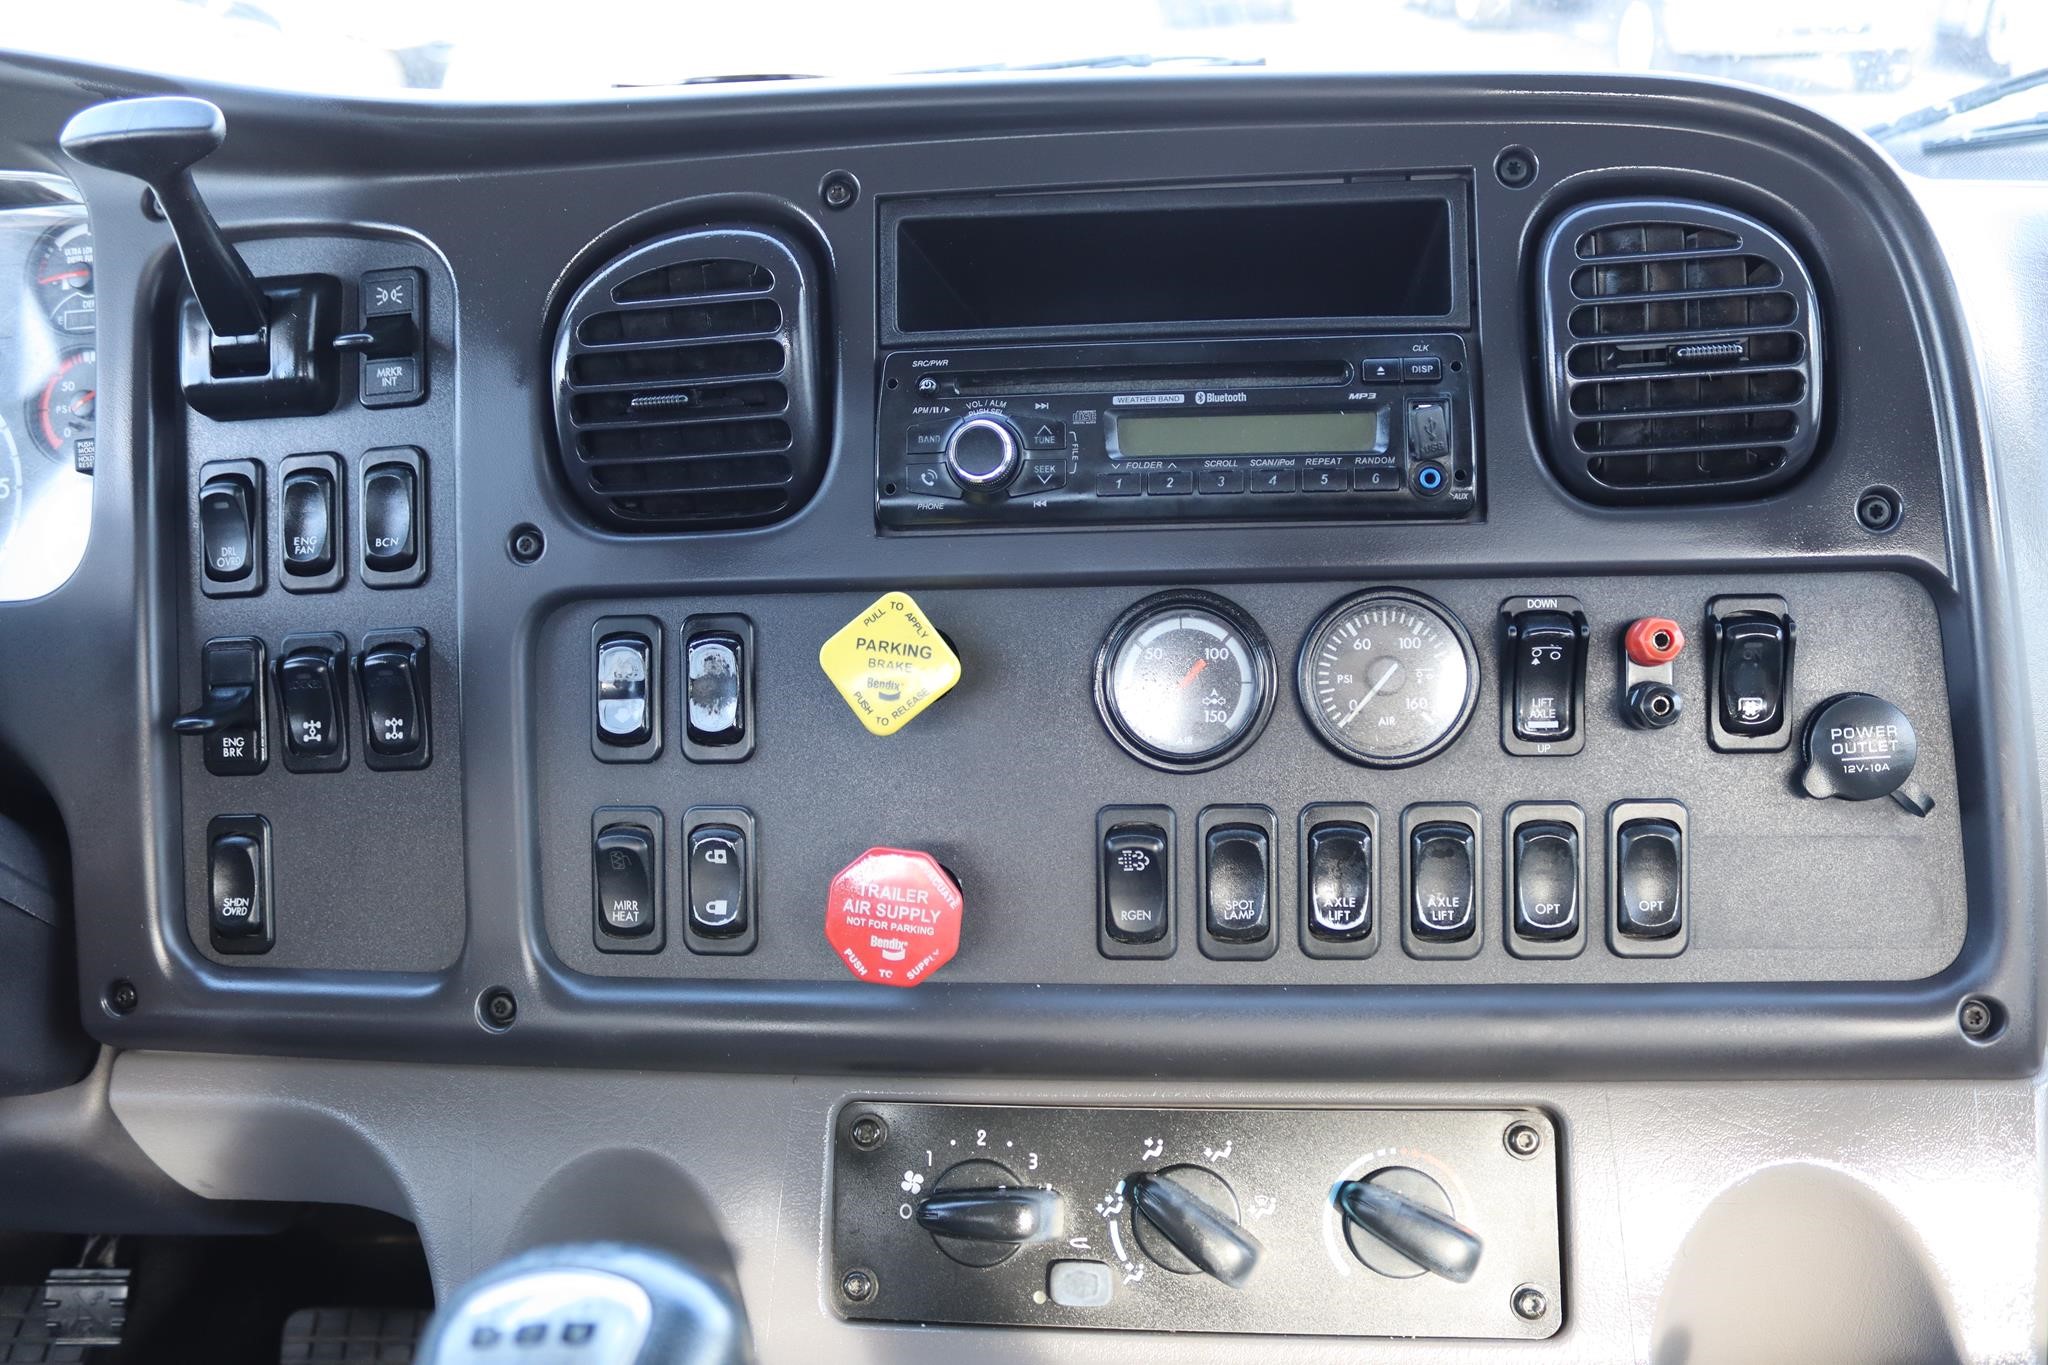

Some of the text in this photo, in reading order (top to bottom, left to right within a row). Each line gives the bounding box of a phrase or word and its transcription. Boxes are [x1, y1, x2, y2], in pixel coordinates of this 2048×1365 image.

[1412, 344, 1429, 352] CLK
[912, 359, 949, 368] SRC/PWR
[1411, 365, 1434, 373] DISP
[376, 366, 403, 378] MRKR
[61, 381, 75, 392] 50
[381, 376, 398, 387] INT
[1118, 395, 1180, 404] WEATHER BAND
[1206, 392, 1247, 402] Bluetooth
[1348, 392, 1377, 400] MP3
[966, 400, 983, 409] VOL
[989, 400, 1007, 409] ALM
[64, 428, 72, 438] 0
[918, 435, 941, 443] BAND
[1034, 436, 1056, 444] TUNE
[1126, 461, 1163, 469] FOLDER
[1204, 460, 1238, 468] SCROLL
[1250, 458, 1295, 467] SCAN/iPod
[1305, 457, 1343, 466] REPEAT
[1354, 457, 1396, 465] RANDOM
[1034, 465, 1056, 473] SEEK
[1115, 478, 1122, 489] 1
[1166, 477, 1174, 488] 2
[1218, 476, 1225, 487] 3
[1268, 475, 1277, 486] 4
[1320, 473, 1329, 485] 5
[1371, 473, 1380, 484] 6
[917, 502, 944, 511] PHONE
[293, 536, 318, 546] ENG
[375, 537, 399, 547] BCN
[221, 547, 237, 557] DRL
[294, 545, 315, 555] FAN
[217, 557, 241, 568] OVRD
[1527, 599, 1558, 609] DOWN
[863, 601, 929, 639] PULL TO APPLY
[856, 637, 932, 660] PARKING
[1353, 638, 1371, 650] 60
[1399, 637, 1421, 649] 100
[1204, 647, 1229, 660] 100
[868, 657, 913, 673] BRAKE
[867, 677, 900, 691] Bendix
[1337, 674, 1353, 684] PSI
[854, 687, 930, 726] PUSH TO RELEASE
[1406, 698, 1428, 710] 160
[1532, 697, 1554, 707] LIFT
[1204, 710, 1227, 723] 150
[1530, 708, 1556, 719] AXLE
[1378, 716, 1395, 727] AIR
[1831, 725, 1897, 741] POWER
[222, 737, 245, 747] ENG
[1831, 740, 1898, 755] OUTLET
[222, 748, 244, 757] BRK
[1537, 743, 1551, 753] UP
[1843, 763, 1891, 773] 12V-10A
[859, 882, 929, 905] TRAILER
[223, 897, 249, 908] SHDN
[613, 900, 639, 911] MIRR
[1225, 900, 1254, 910] SPOT
[1324, 897, 1356, 908] AXLE
[1427, 897, 1460, 908] AXLE
[1638, 900, 1664, 912] OPT
[222, 906, 248, 917] OVRD
[843, 898, 941, 924] AIR SUPPLY
[1535, 903, 1561, 915] OPT
[612, 911, 639, 922] HEAT
[1121, 910, 1151, 921] RGEN
[1224, 910, 1255, 921] LAMP
[1328, 910, 1351, 921] LIFT
[1432, 910, 1454, 922] LIFT
[846, 916, 935, 936] NOT FOR PARKING
[870, 935, 906, 950] Bendix
[844, 948, 868, 976] PUSH
[976, 1129, 986, 1146] 2
[926, 1150, 932, 1167] 1
[1028, 1152, 1038, 1170] 3
